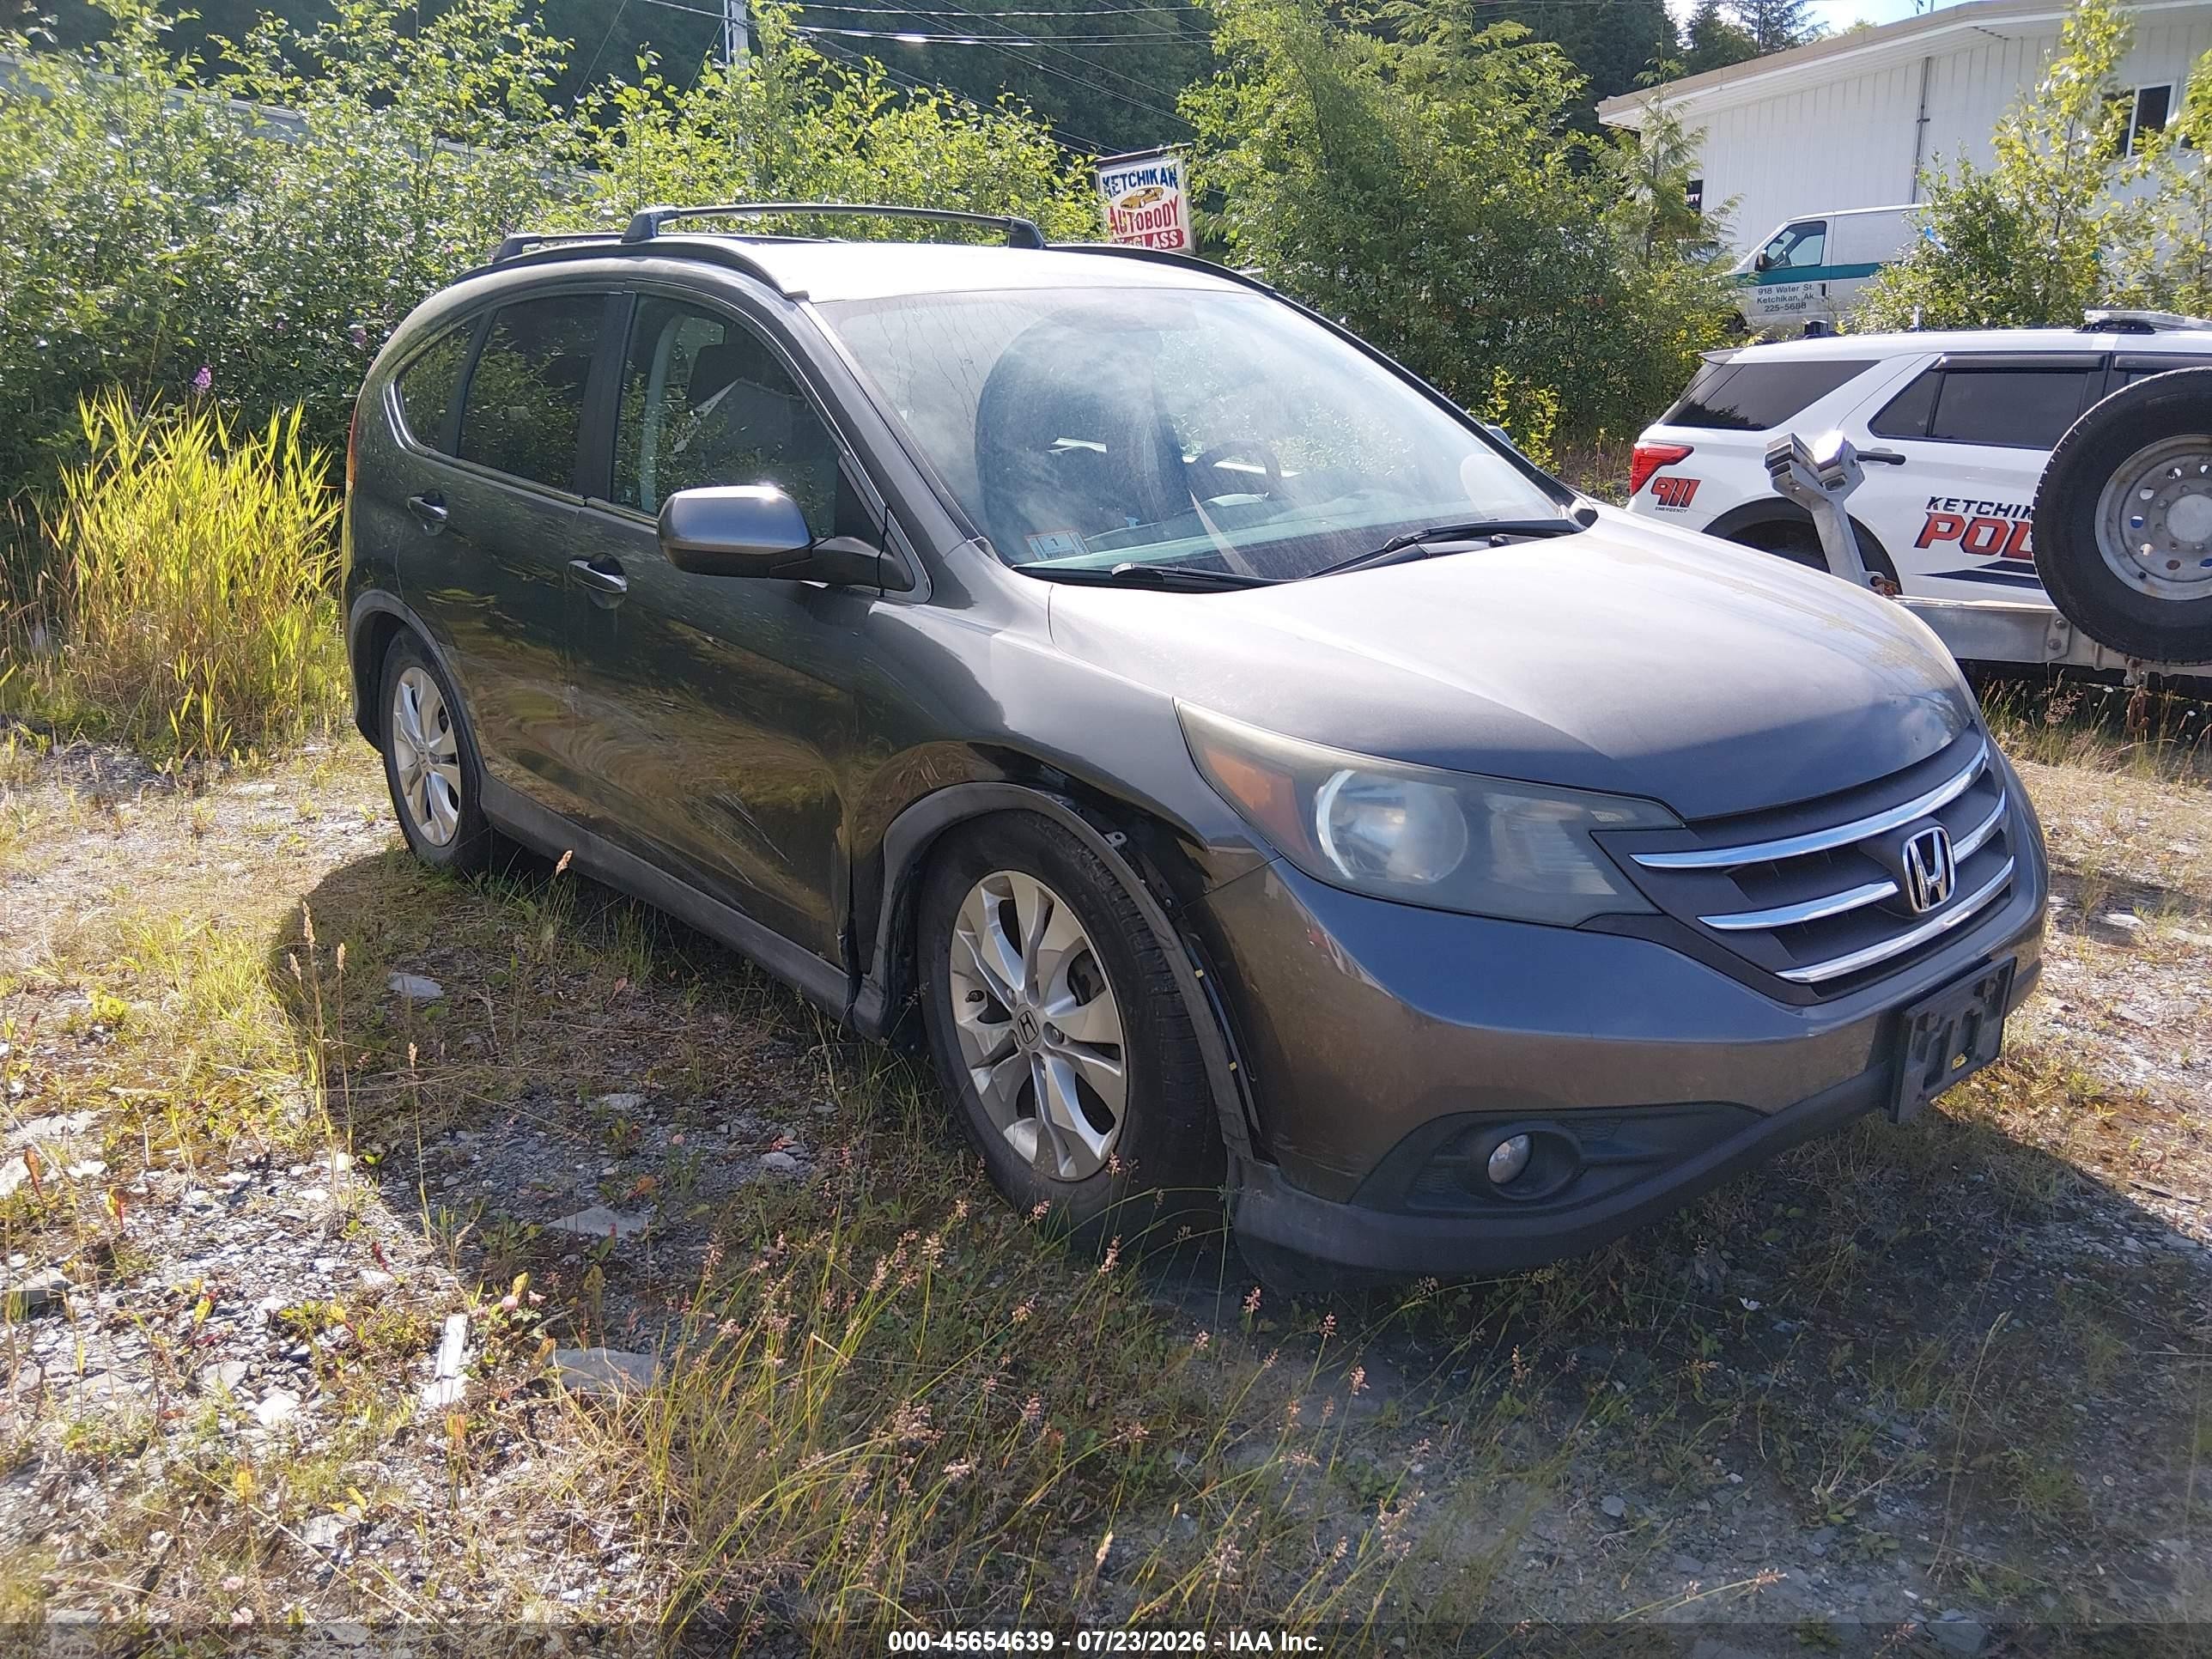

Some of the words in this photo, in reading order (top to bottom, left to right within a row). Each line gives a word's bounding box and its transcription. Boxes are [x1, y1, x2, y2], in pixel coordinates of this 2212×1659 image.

[1103, 167, 1179, 198] KETCHIKAN
[1109, 195, 1179, 234] AUTOBODY
[1757, 295, 1800, 304] Ketchikan,
[1650, 477, 1701, 507] 911
[1913, 511, 2033, 561] POL
